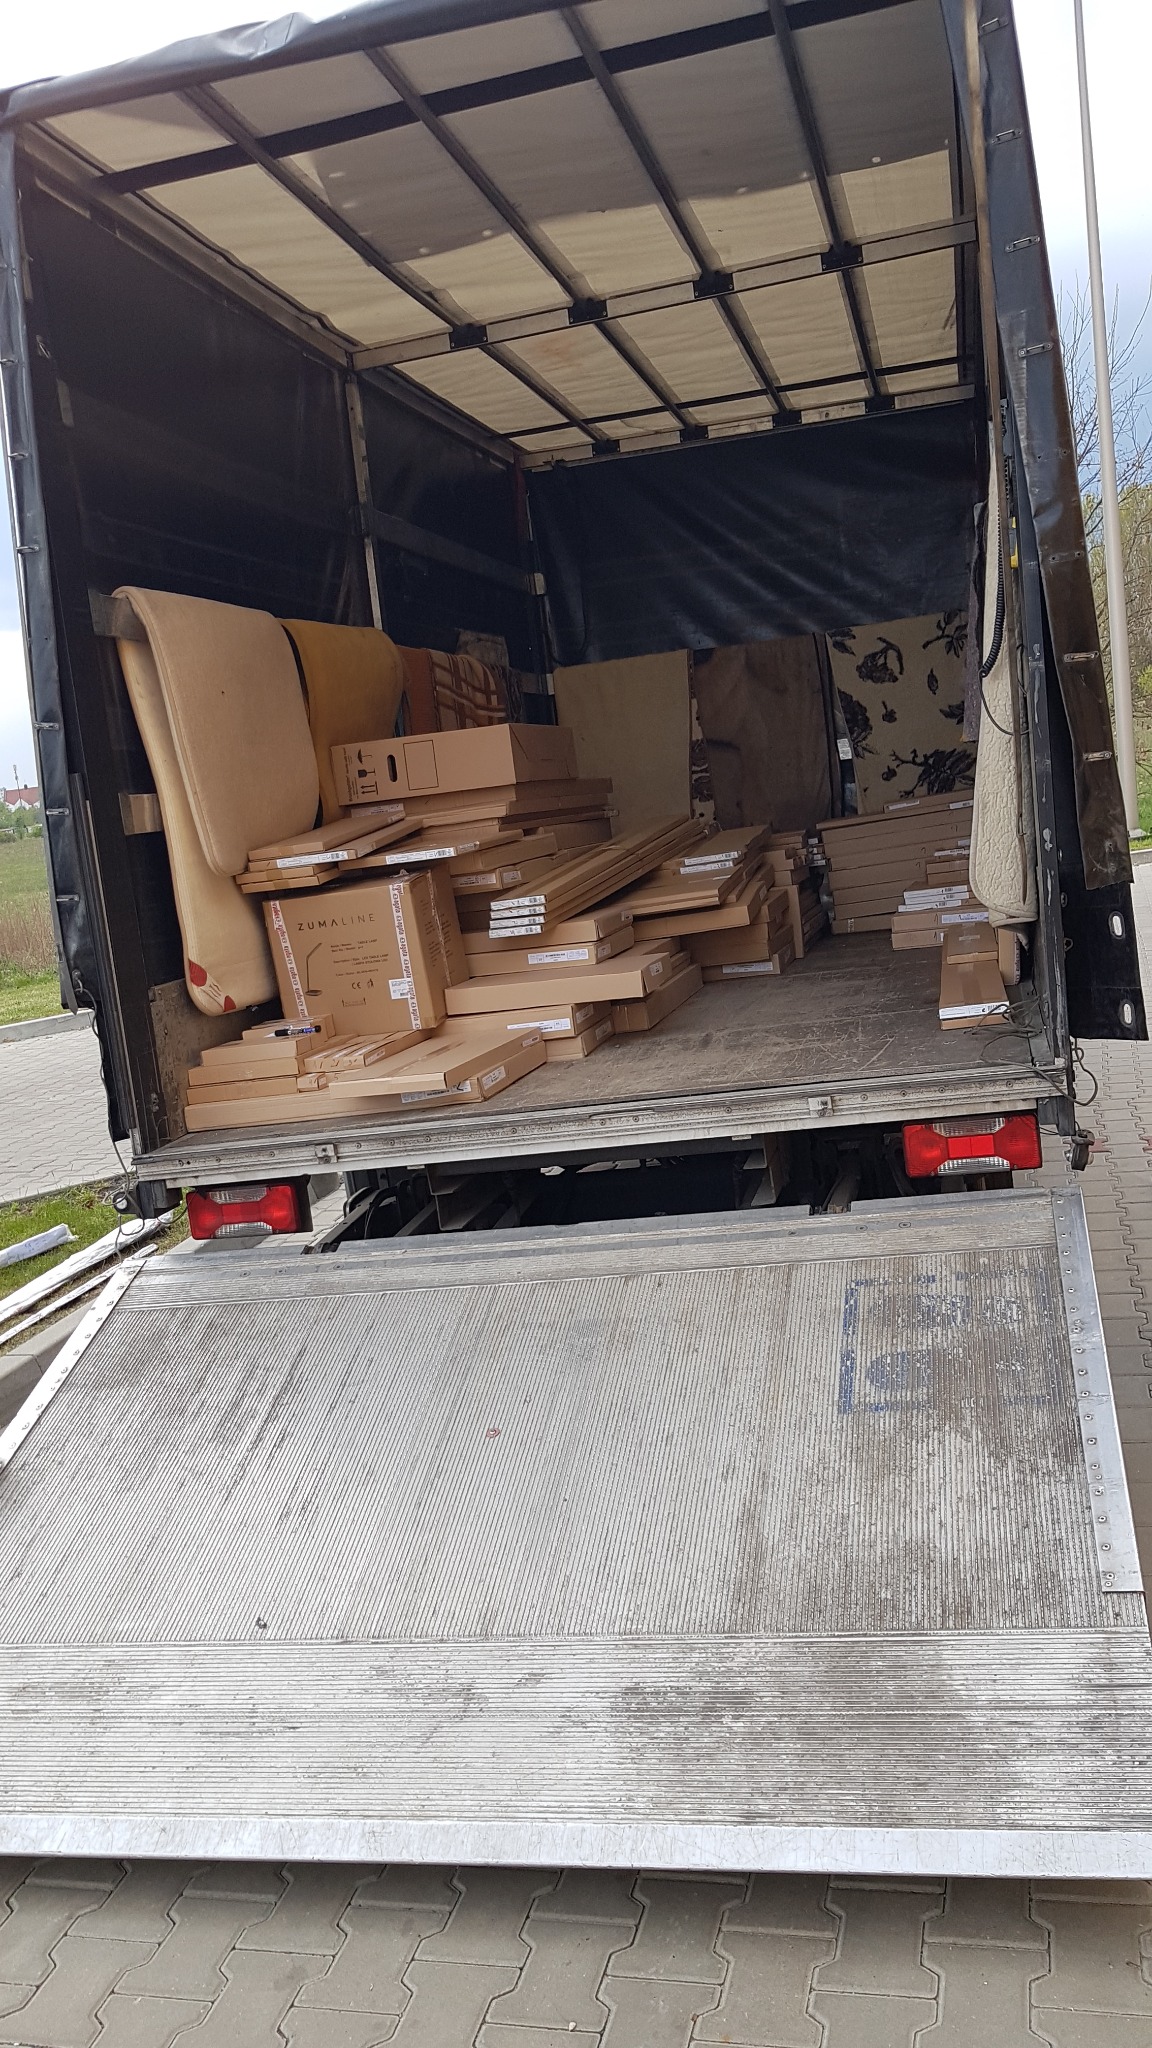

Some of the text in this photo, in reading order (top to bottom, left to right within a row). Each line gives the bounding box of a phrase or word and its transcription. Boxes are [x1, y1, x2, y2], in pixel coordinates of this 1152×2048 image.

[298, 914, 376, 931] ZUMALINE
[400, 944, 408, 957] agata
[404, 966, 412, 978] agata
[352, 982, 362, 990] CE
